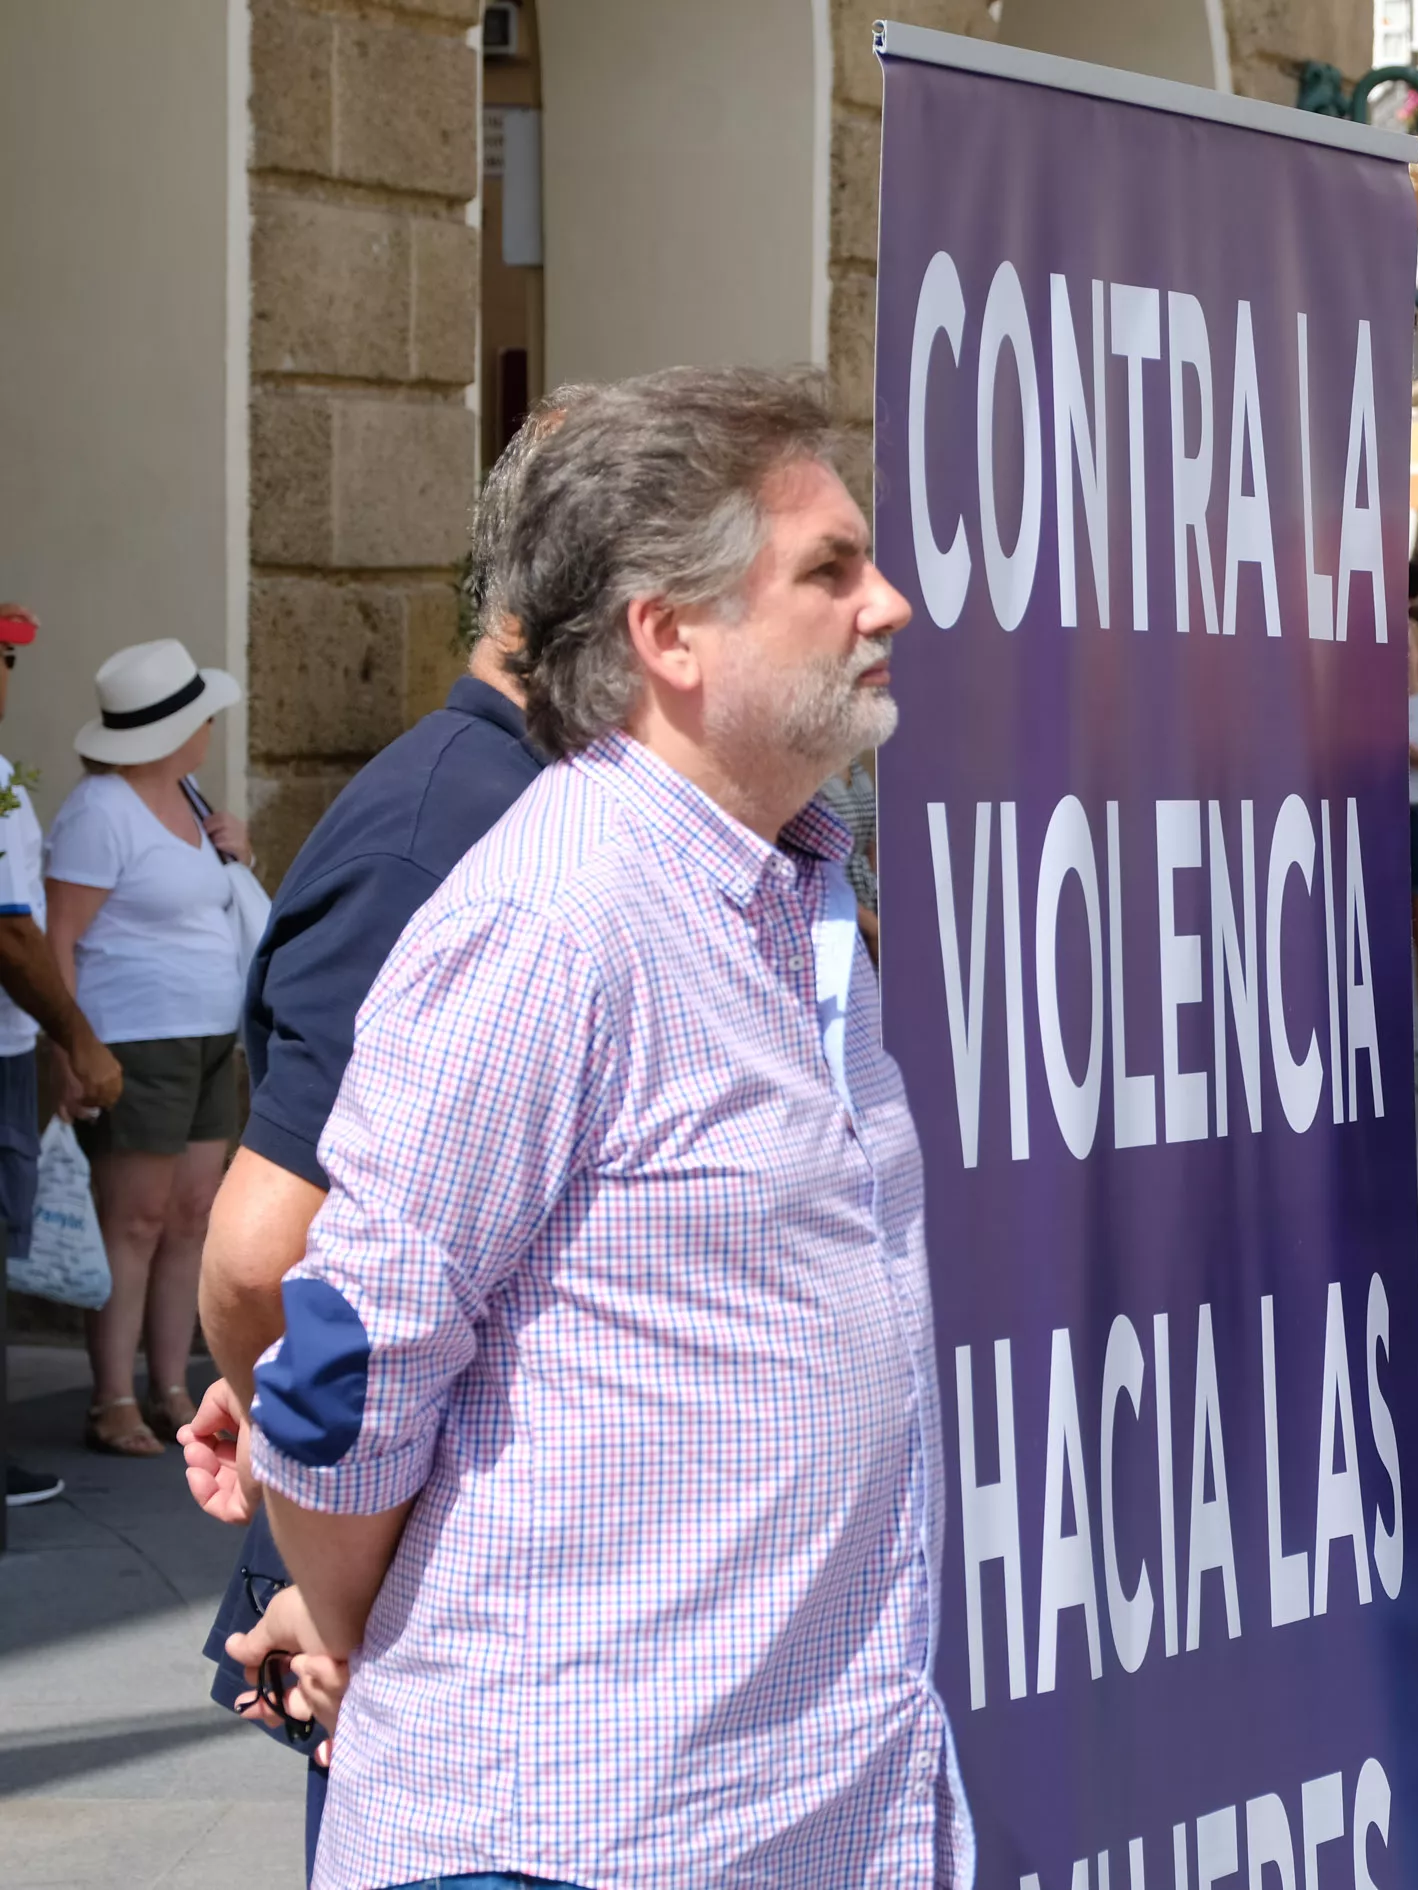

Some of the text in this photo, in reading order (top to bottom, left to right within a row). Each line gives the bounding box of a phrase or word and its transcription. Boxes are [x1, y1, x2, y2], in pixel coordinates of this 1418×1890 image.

[908, 250, 1388, 643] CONTRA LA
[926, 793, 1385, 1169] VIOLENCIA
[955, 1272, 1404, 1711] HACIA LAS
